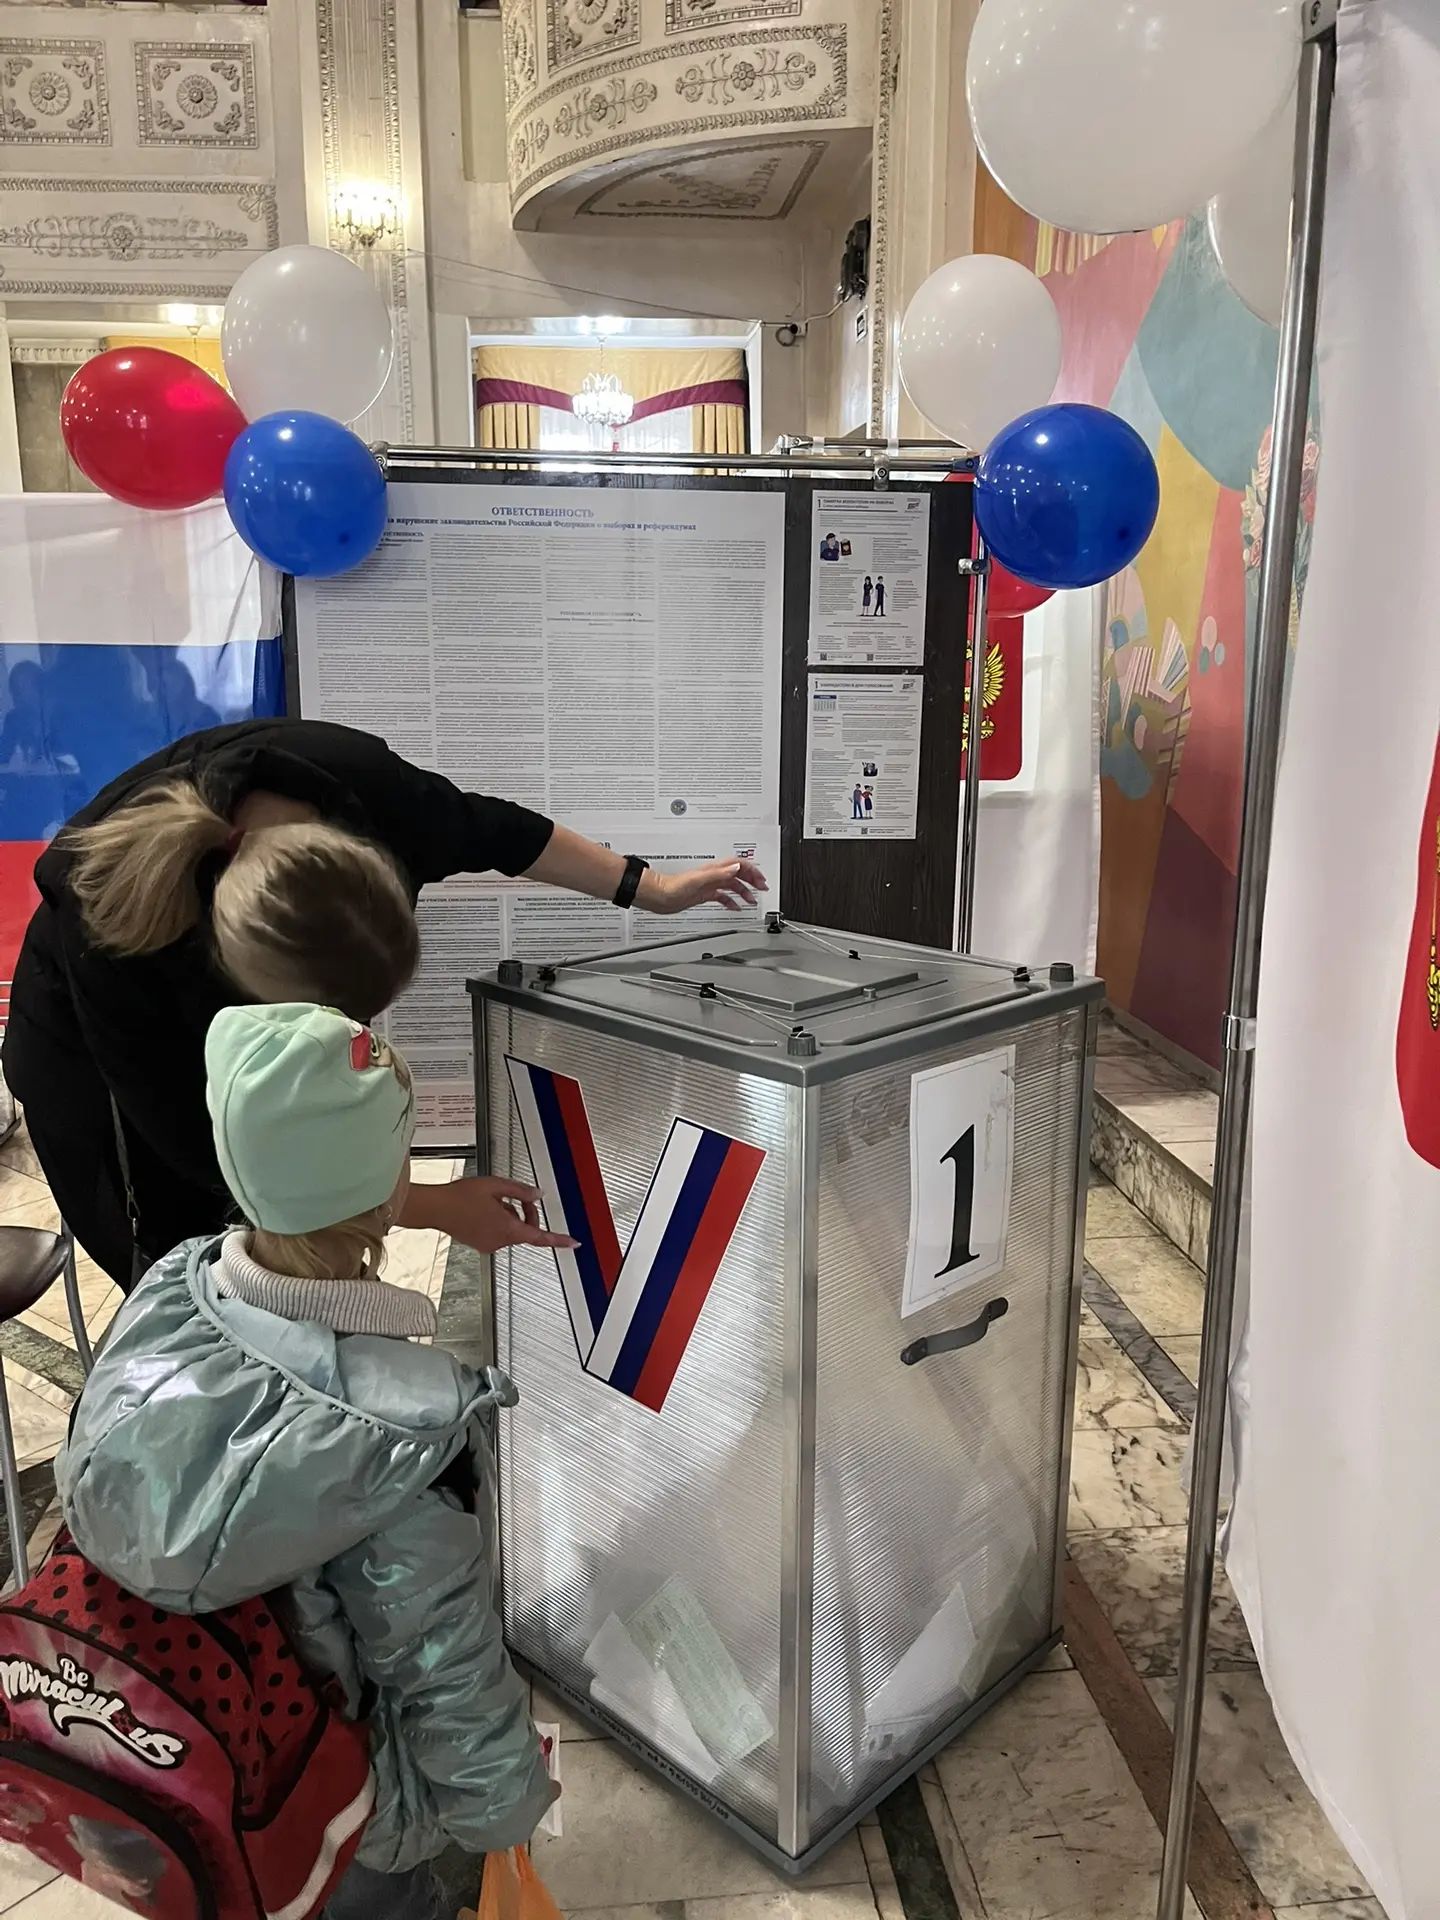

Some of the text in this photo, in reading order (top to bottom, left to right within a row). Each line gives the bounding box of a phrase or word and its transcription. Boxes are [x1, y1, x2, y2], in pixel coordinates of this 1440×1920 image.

[491, 507, 594, 518] ОТВЕТСТВЕННОСТЬ
[508, 518, 552, 527] Российской
[643, 522, 696, 532] референдумах
[934, 1123, 980, 1278] 1
[60, 1658, 89, 1688] Be
